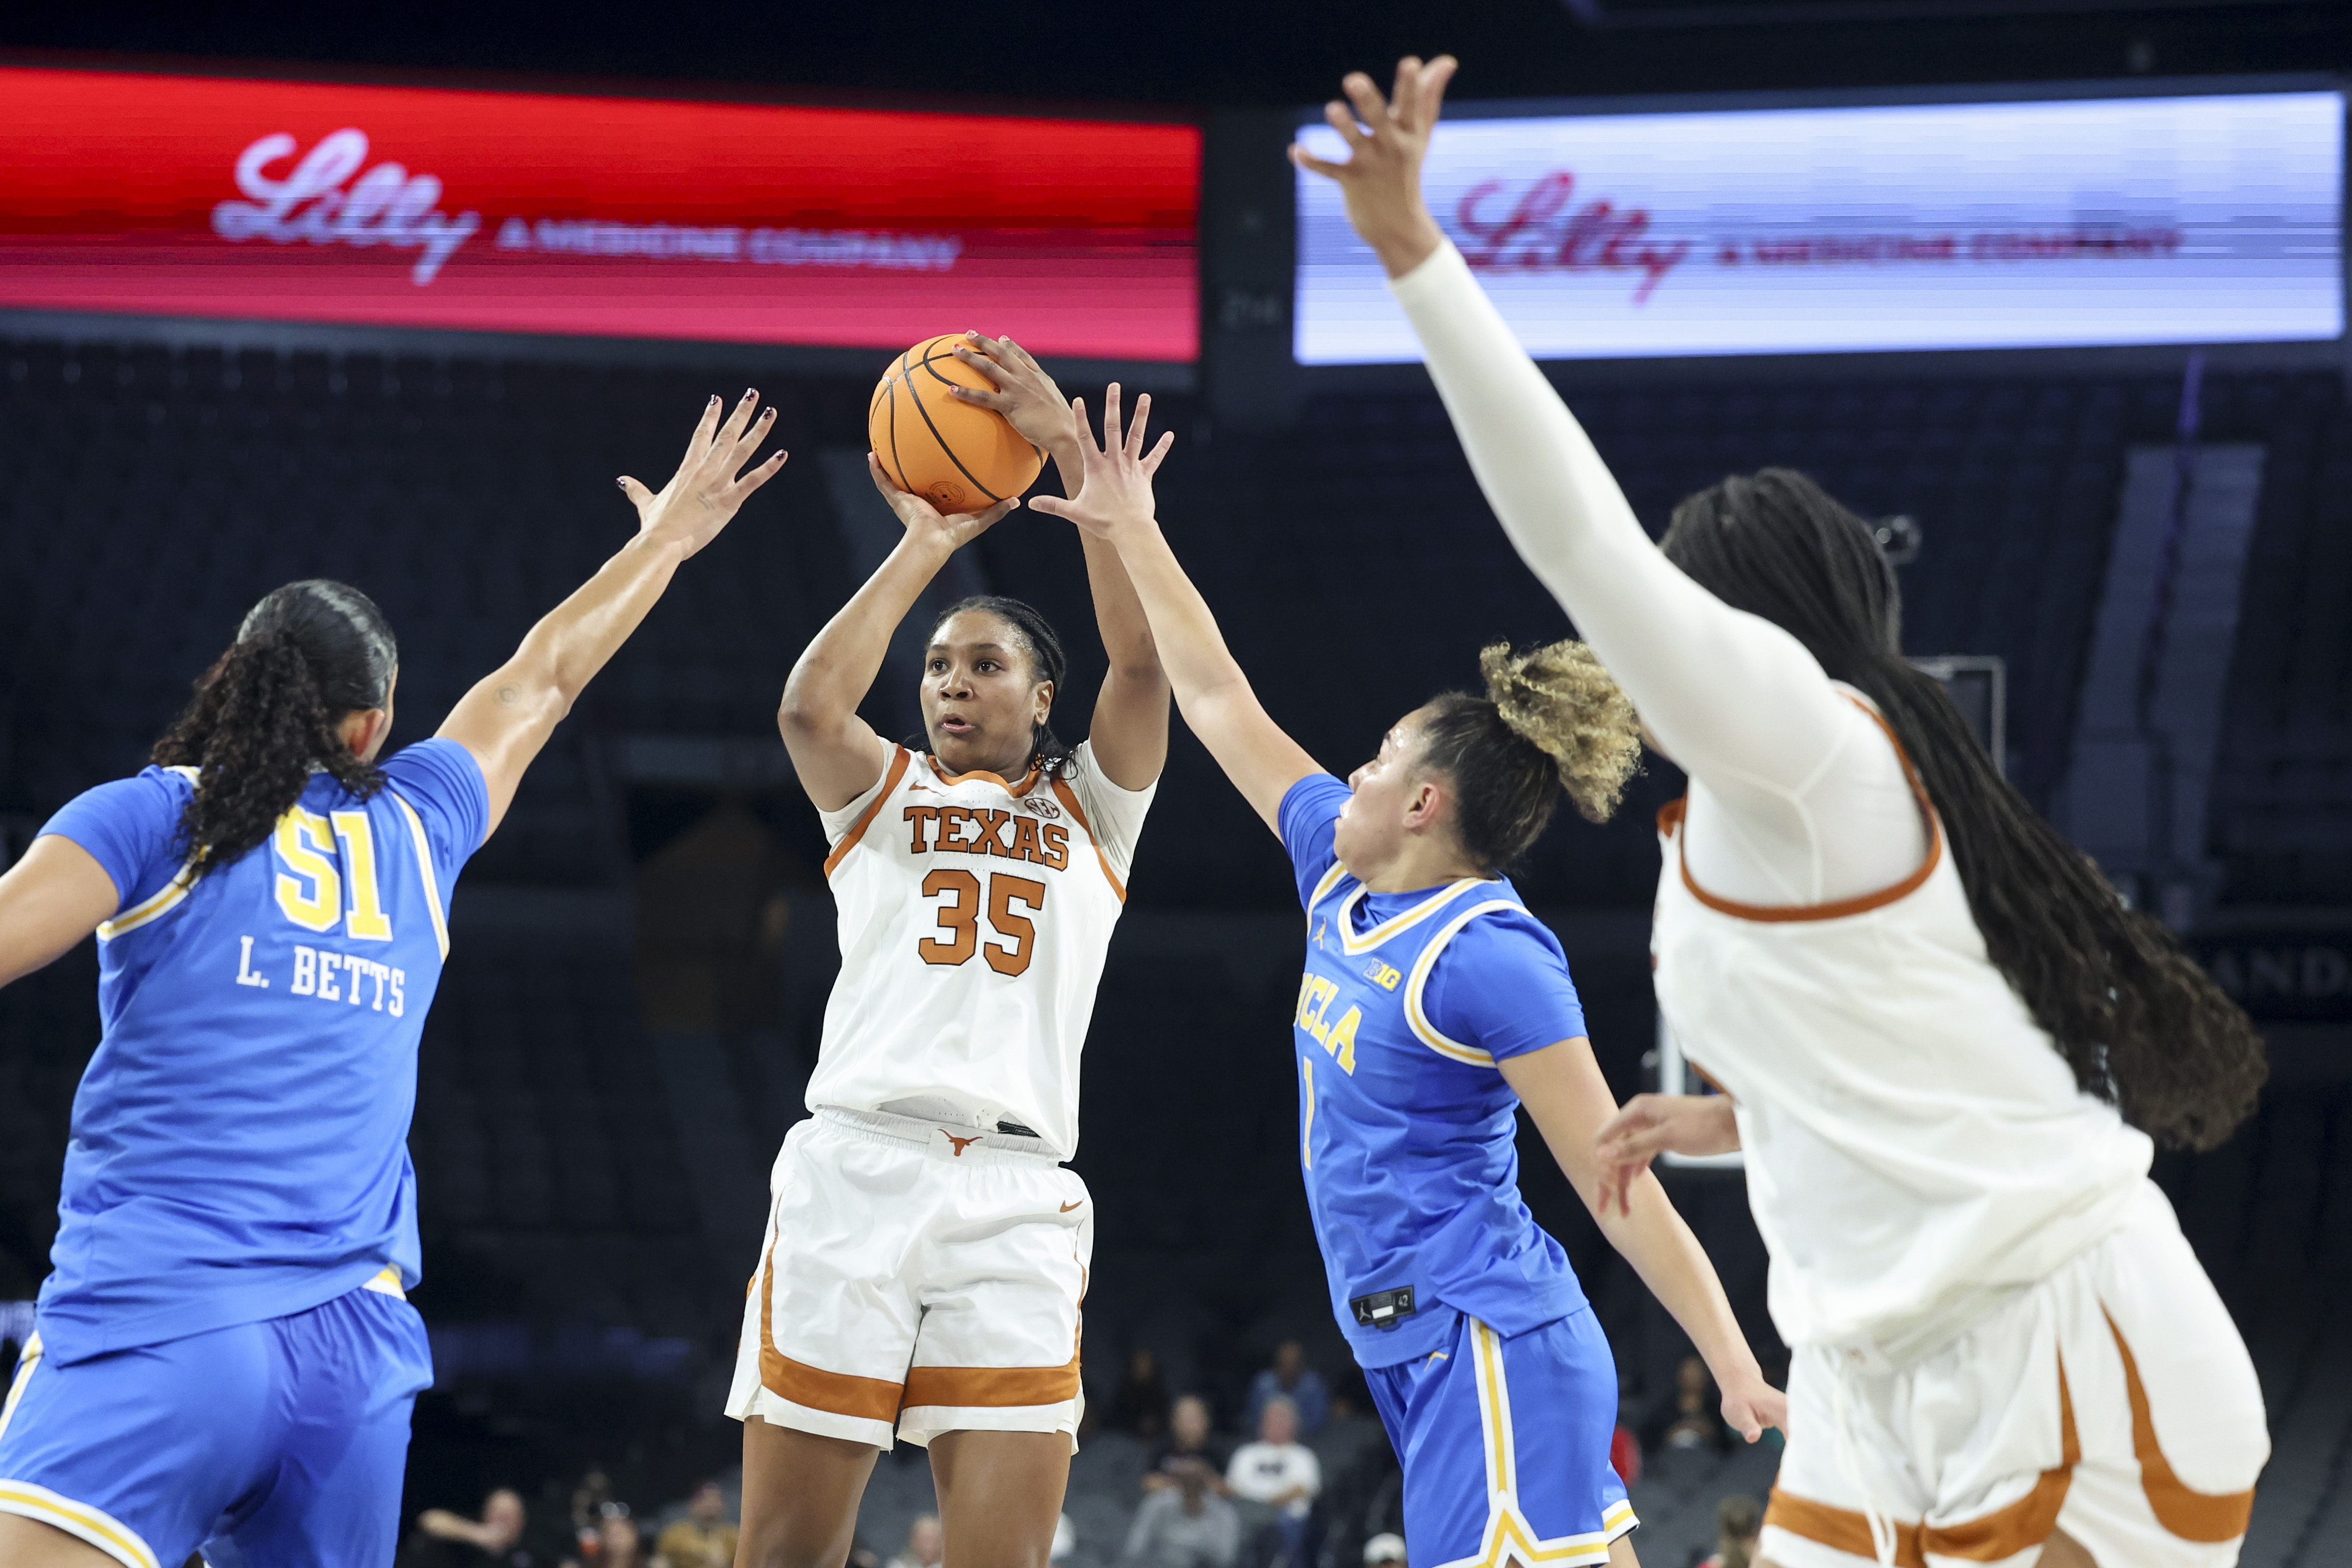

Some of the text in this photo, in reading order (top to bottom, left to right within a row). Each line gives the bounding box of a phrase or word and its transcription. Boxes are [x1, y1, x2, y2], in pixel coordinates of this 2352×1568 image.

[211, 127, 480, 286] Lilly
[497, 215, 530, 251] A
[1457, 171, 1689, 308] Lilly
[903, 806, 1069, 871] TEXAS
[1025, 798, 1060, 818] SEC
[274, 804, 393, 942] 51
[918, 869, 1046, 977] 35
[236, 936, 405, 1017] L. BETTS
[1303, 1056, 1315, 1171] 1
